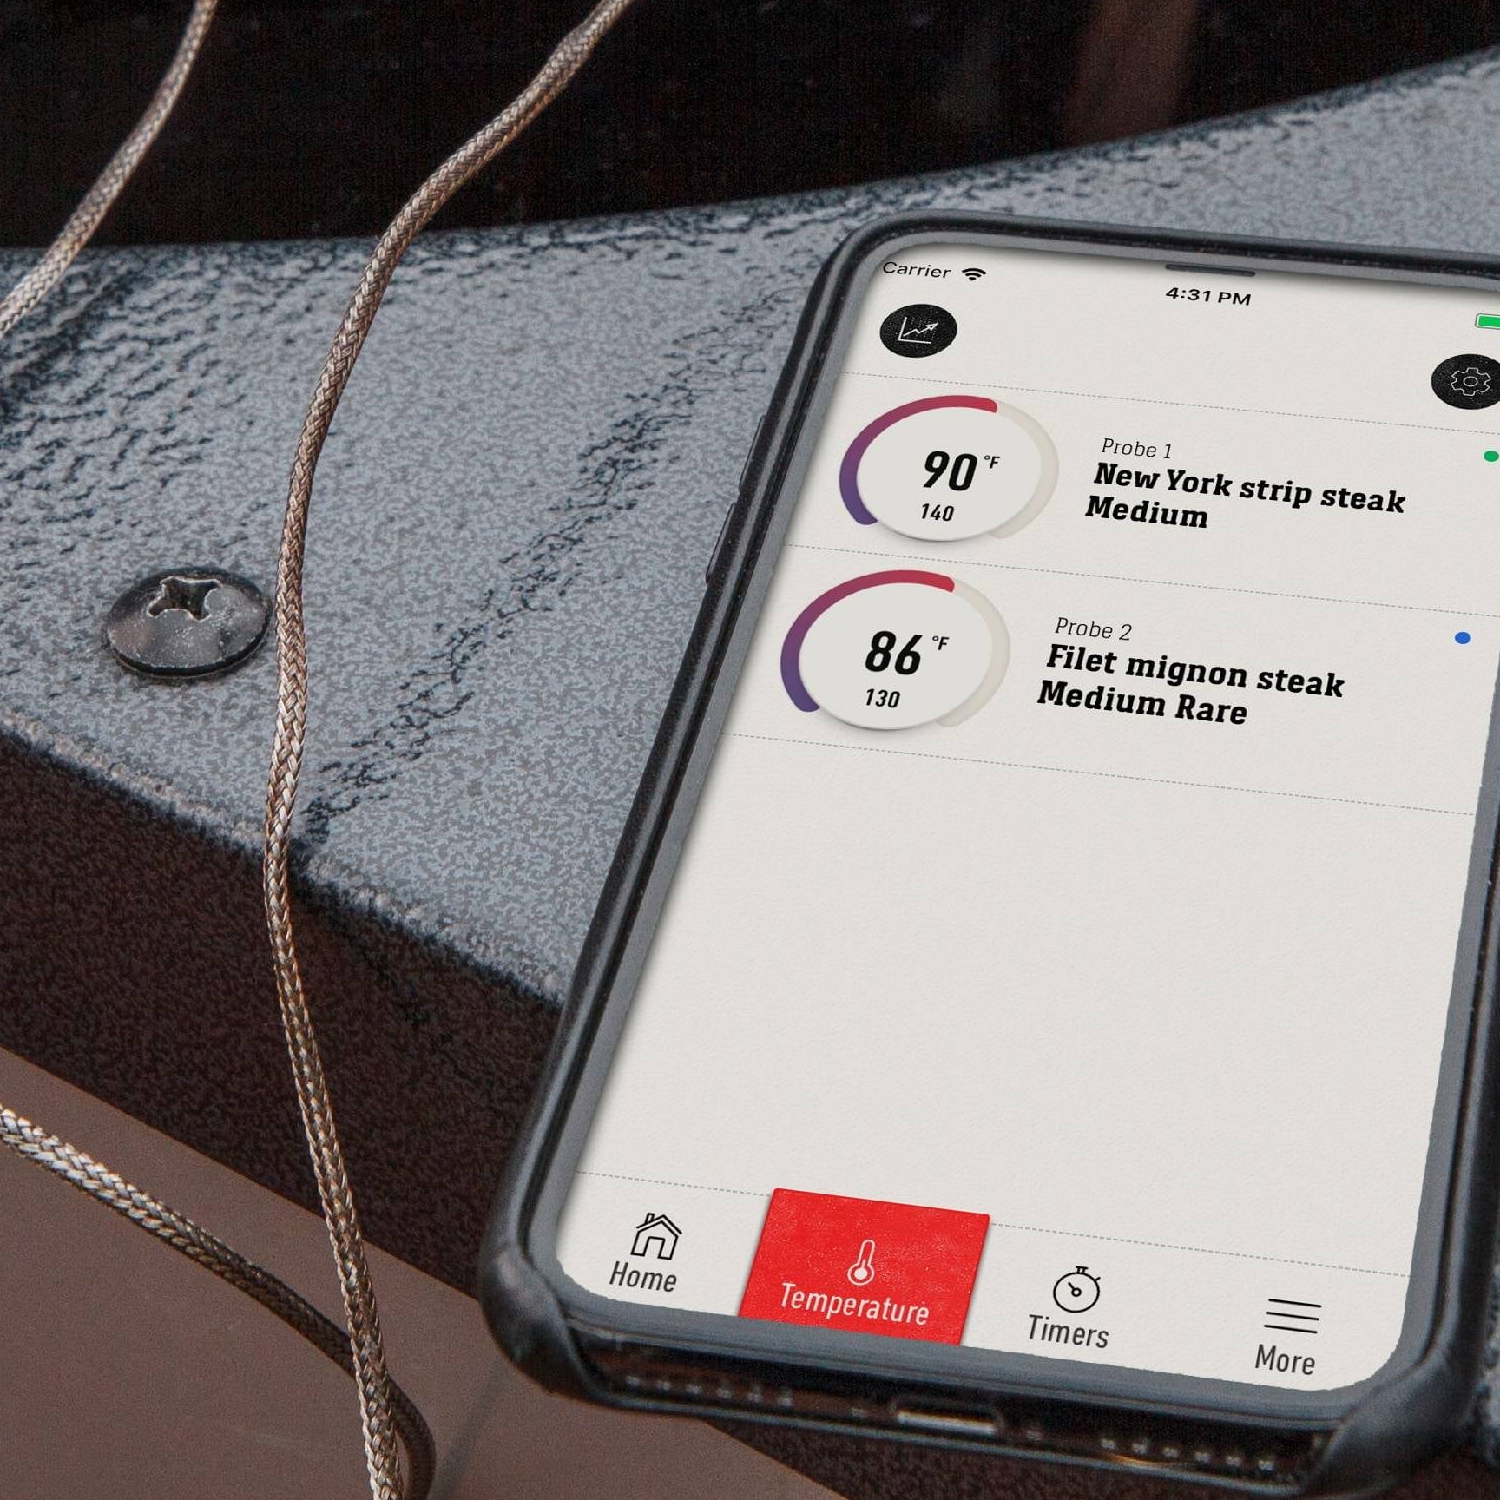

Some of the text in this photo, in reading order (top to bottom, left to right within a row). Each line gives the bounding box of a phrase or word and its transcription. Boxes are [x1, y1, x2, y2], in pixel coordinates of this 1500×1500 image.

[882, 260, 952, 279] Carrier
[1166, 287, 1251, 306] 4:31 PM
[1102, 438, 1172, 459] Probe 1
[1094, 462, 1405, 513] New York strip steak
[922, 503, 954, 521] 140
[1085, 495, 1207, 528] Medium
[1055, 617, 1132, 641] Probe 2
[1047, 644, 1345, 697] Filet mignon steak
[866, 688, 900, 708] 130
[1037, 680, 1247, 725] Medium Rare
[609, 1262, 676, 1292] Home
[782, 1283, 929, 1325] Temperature
[1029, 1314, 1109, 1348] Timers
[1255, 1345, 1315, 1375] More
